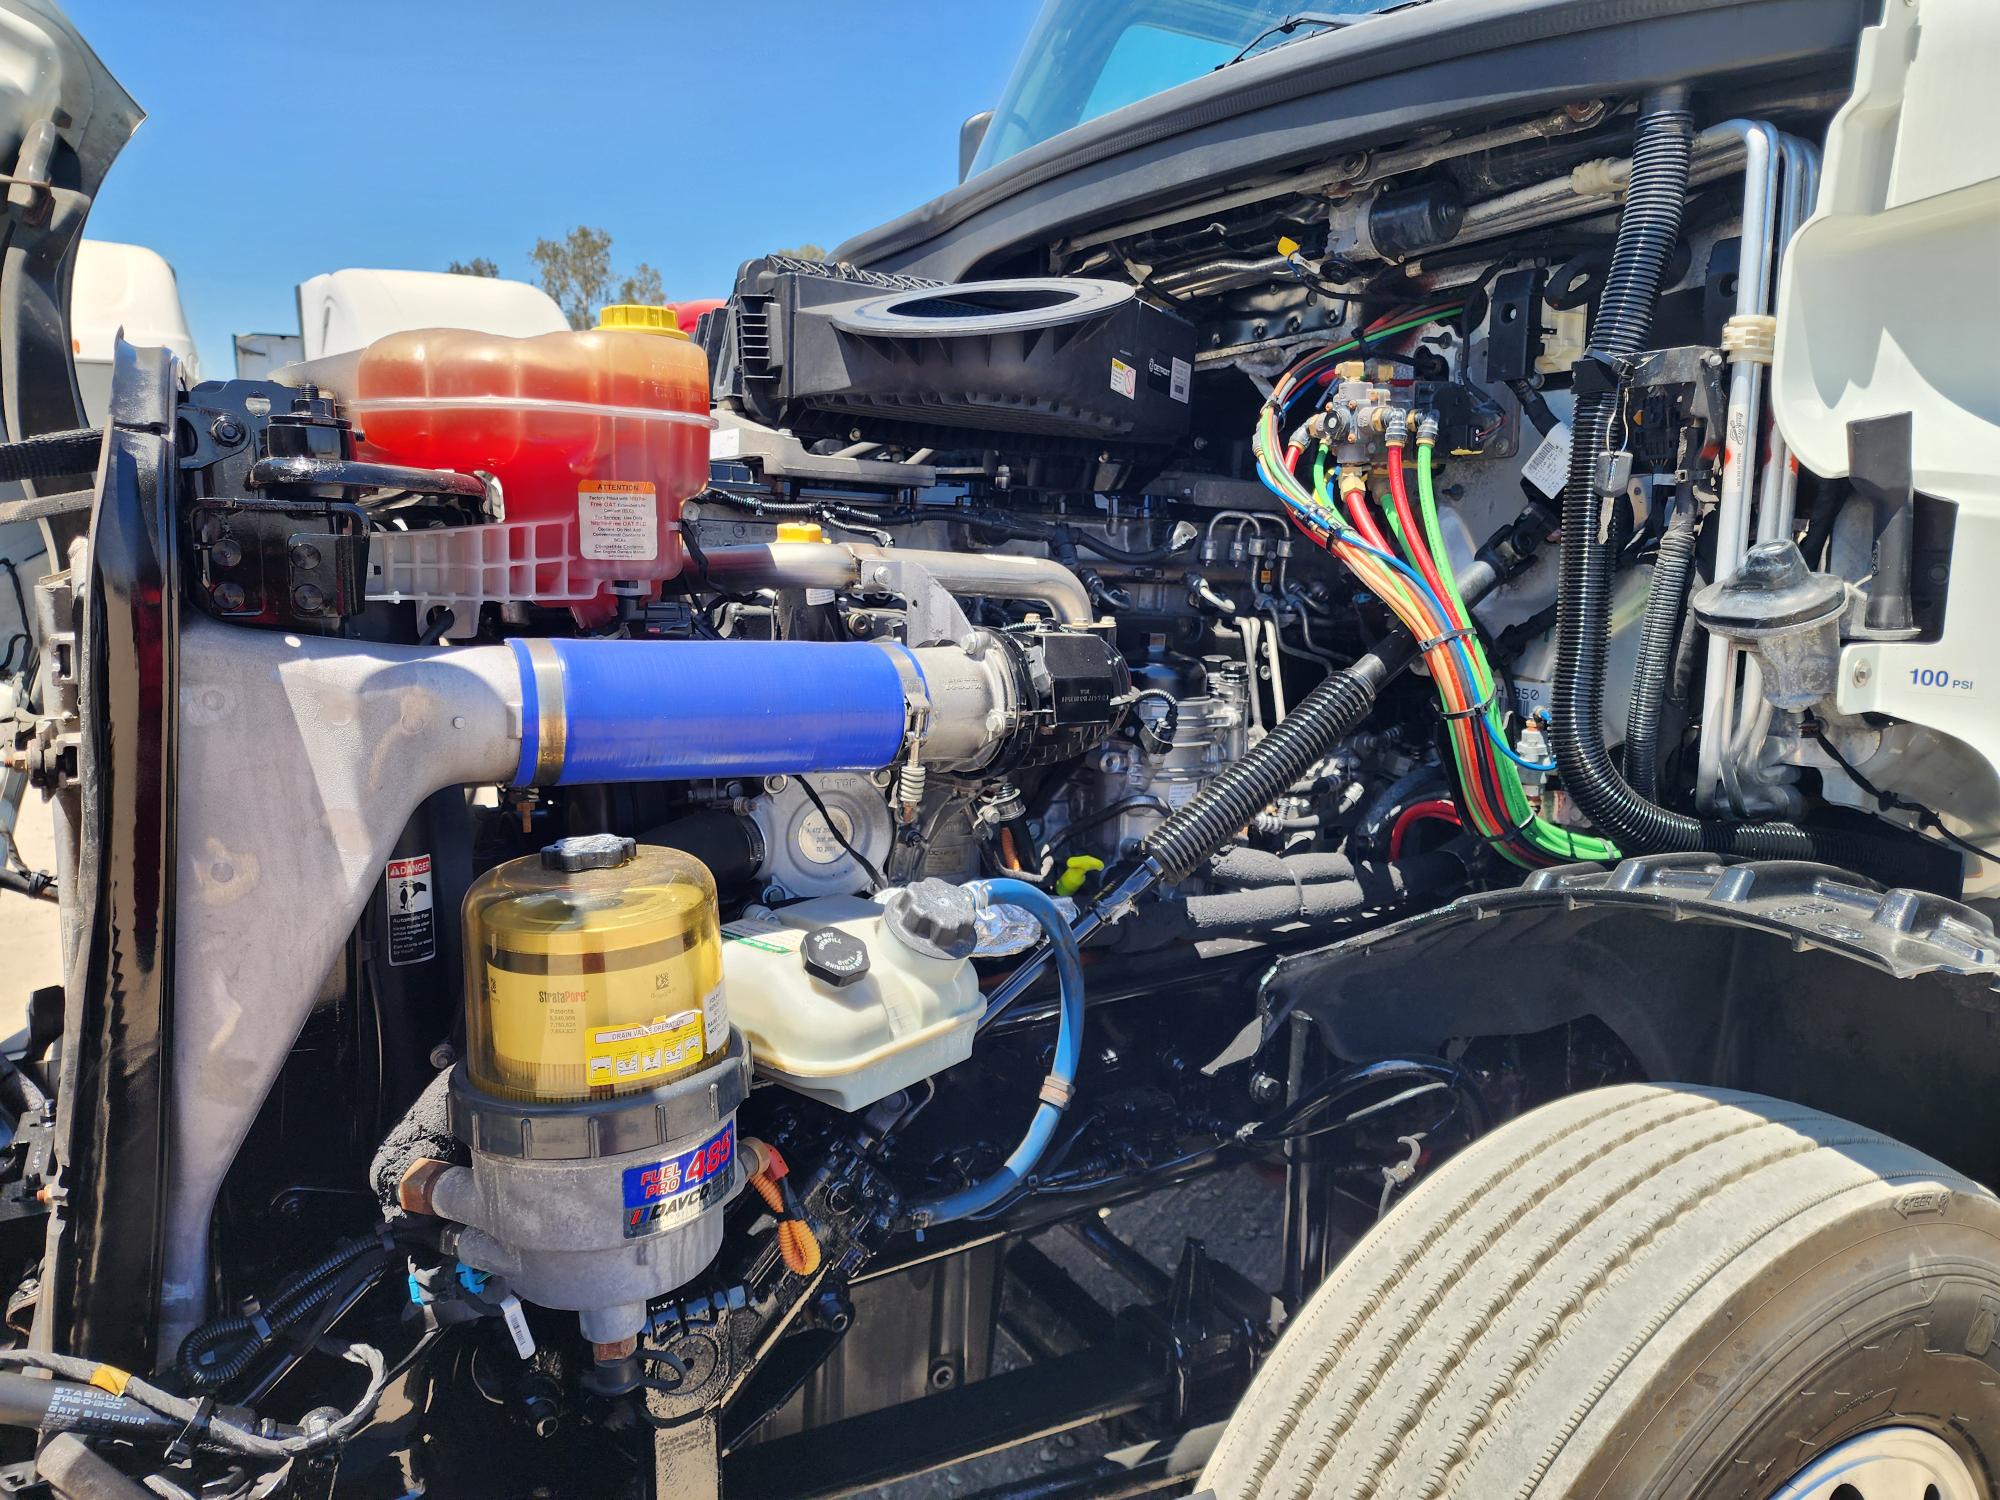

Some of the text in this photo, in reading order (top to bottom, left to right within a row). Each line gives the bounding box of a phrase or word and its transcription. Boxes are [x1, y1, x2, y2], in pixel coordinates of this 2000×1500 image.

[597, 483, 639, 491] ATTENTION
[1909, 668, 1974, 691] 100 PSI
[400, 861, 431, 874] DANGER
[611, 1030, 632, 1041] DRAIN
[653, 1018, 685, 1032] OPERATION
[640, 1128, 733, 1186] FUEL 485
[644, 1176, 681, 1200] PRO
[649, 1182, 712, 1221] DAVCO
